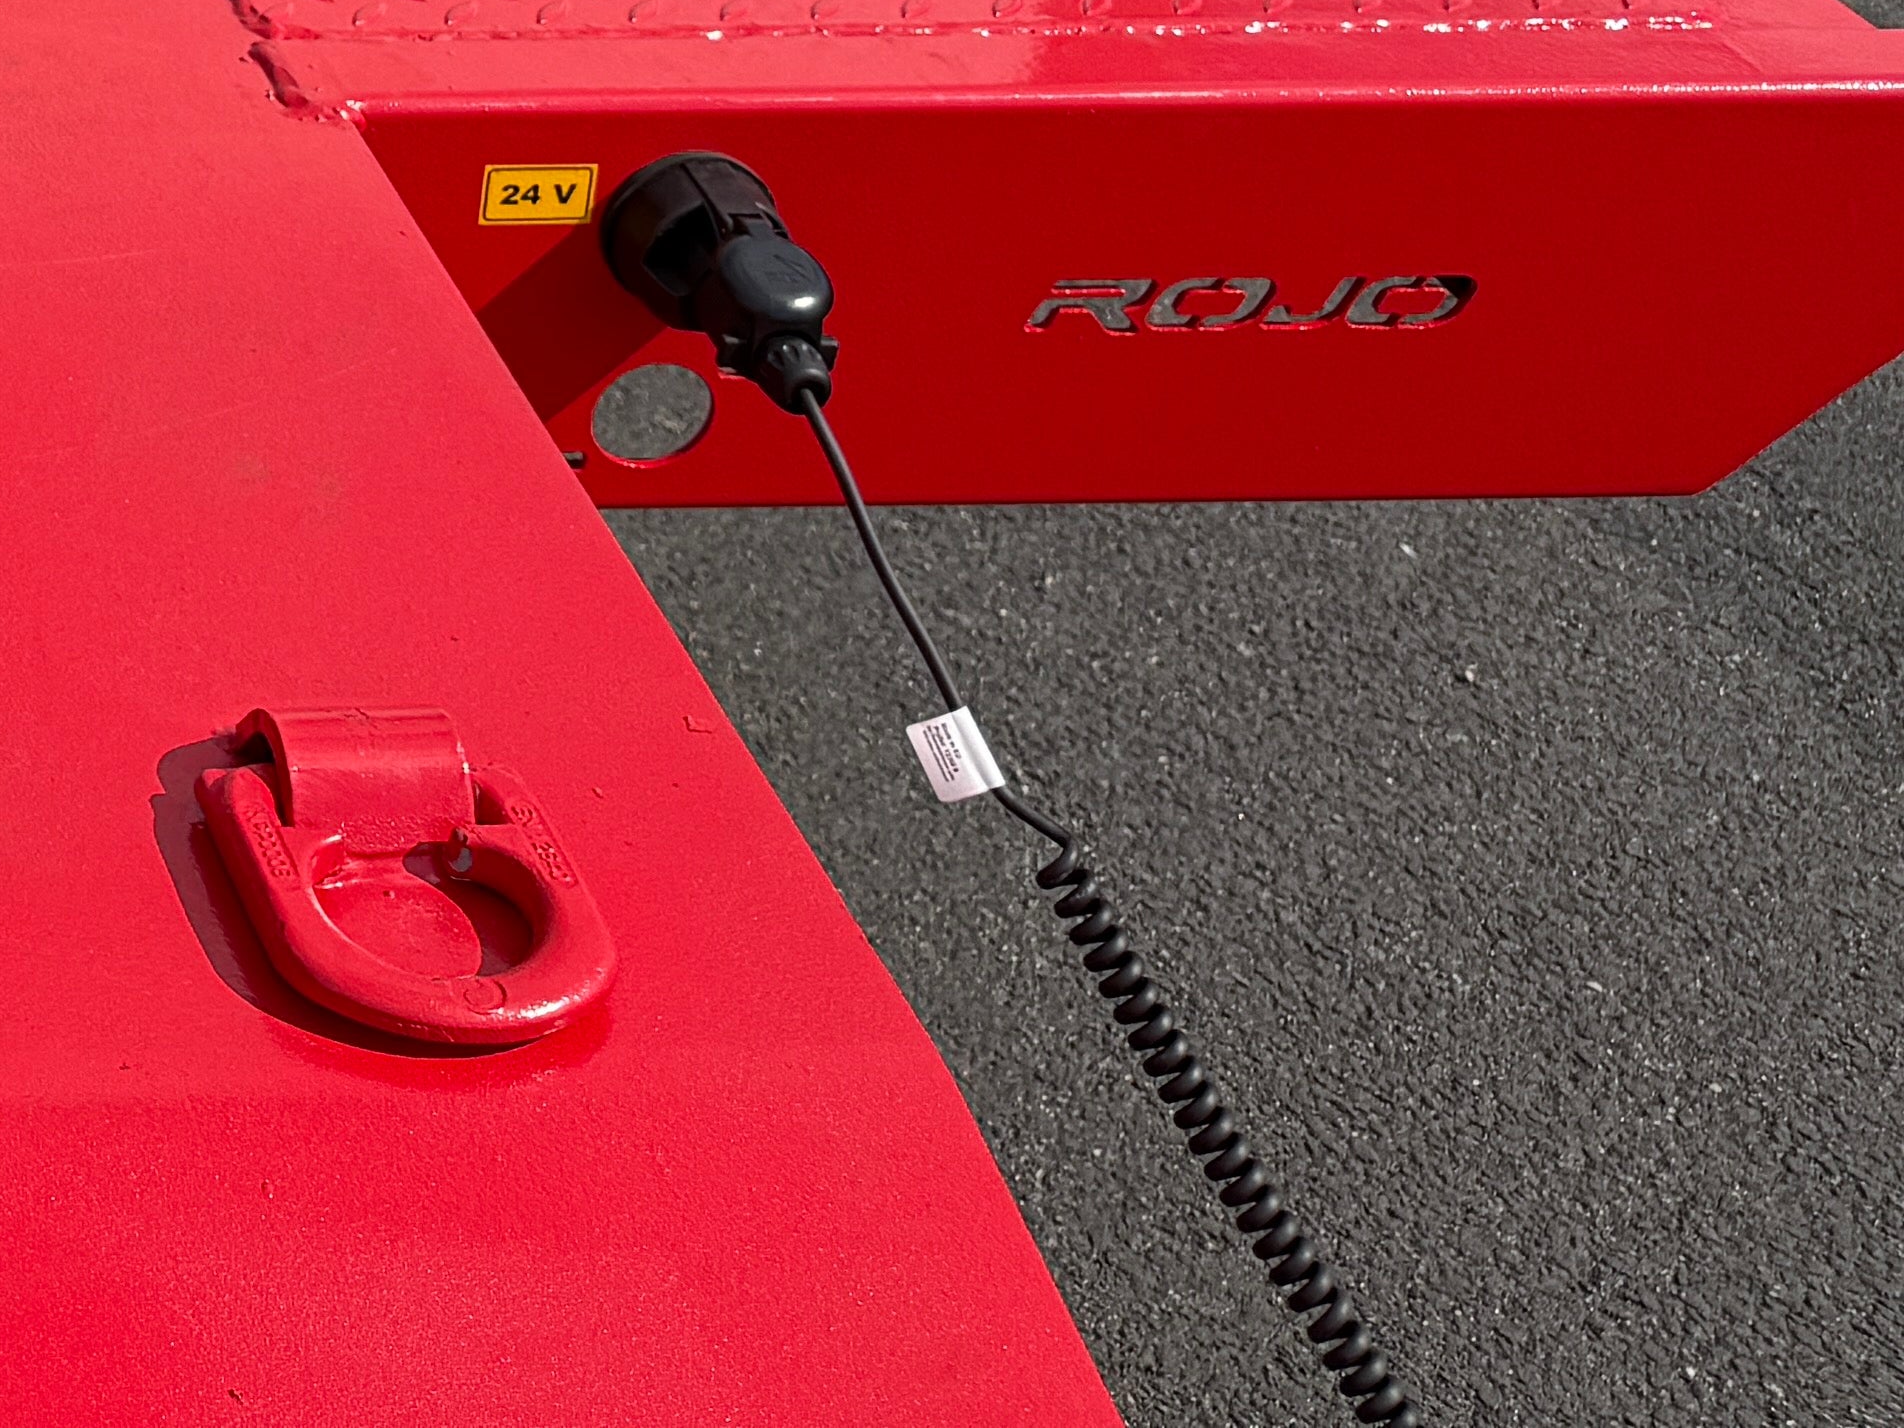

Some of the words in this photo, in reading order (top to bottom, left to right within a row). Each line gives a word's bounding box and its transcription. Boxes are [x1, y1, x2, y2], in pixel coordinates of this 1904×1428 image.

[499, 183, 541, 205] 24
[553, 183, 577, 205] V
[1024, 274, 1478, 335] ROJO
